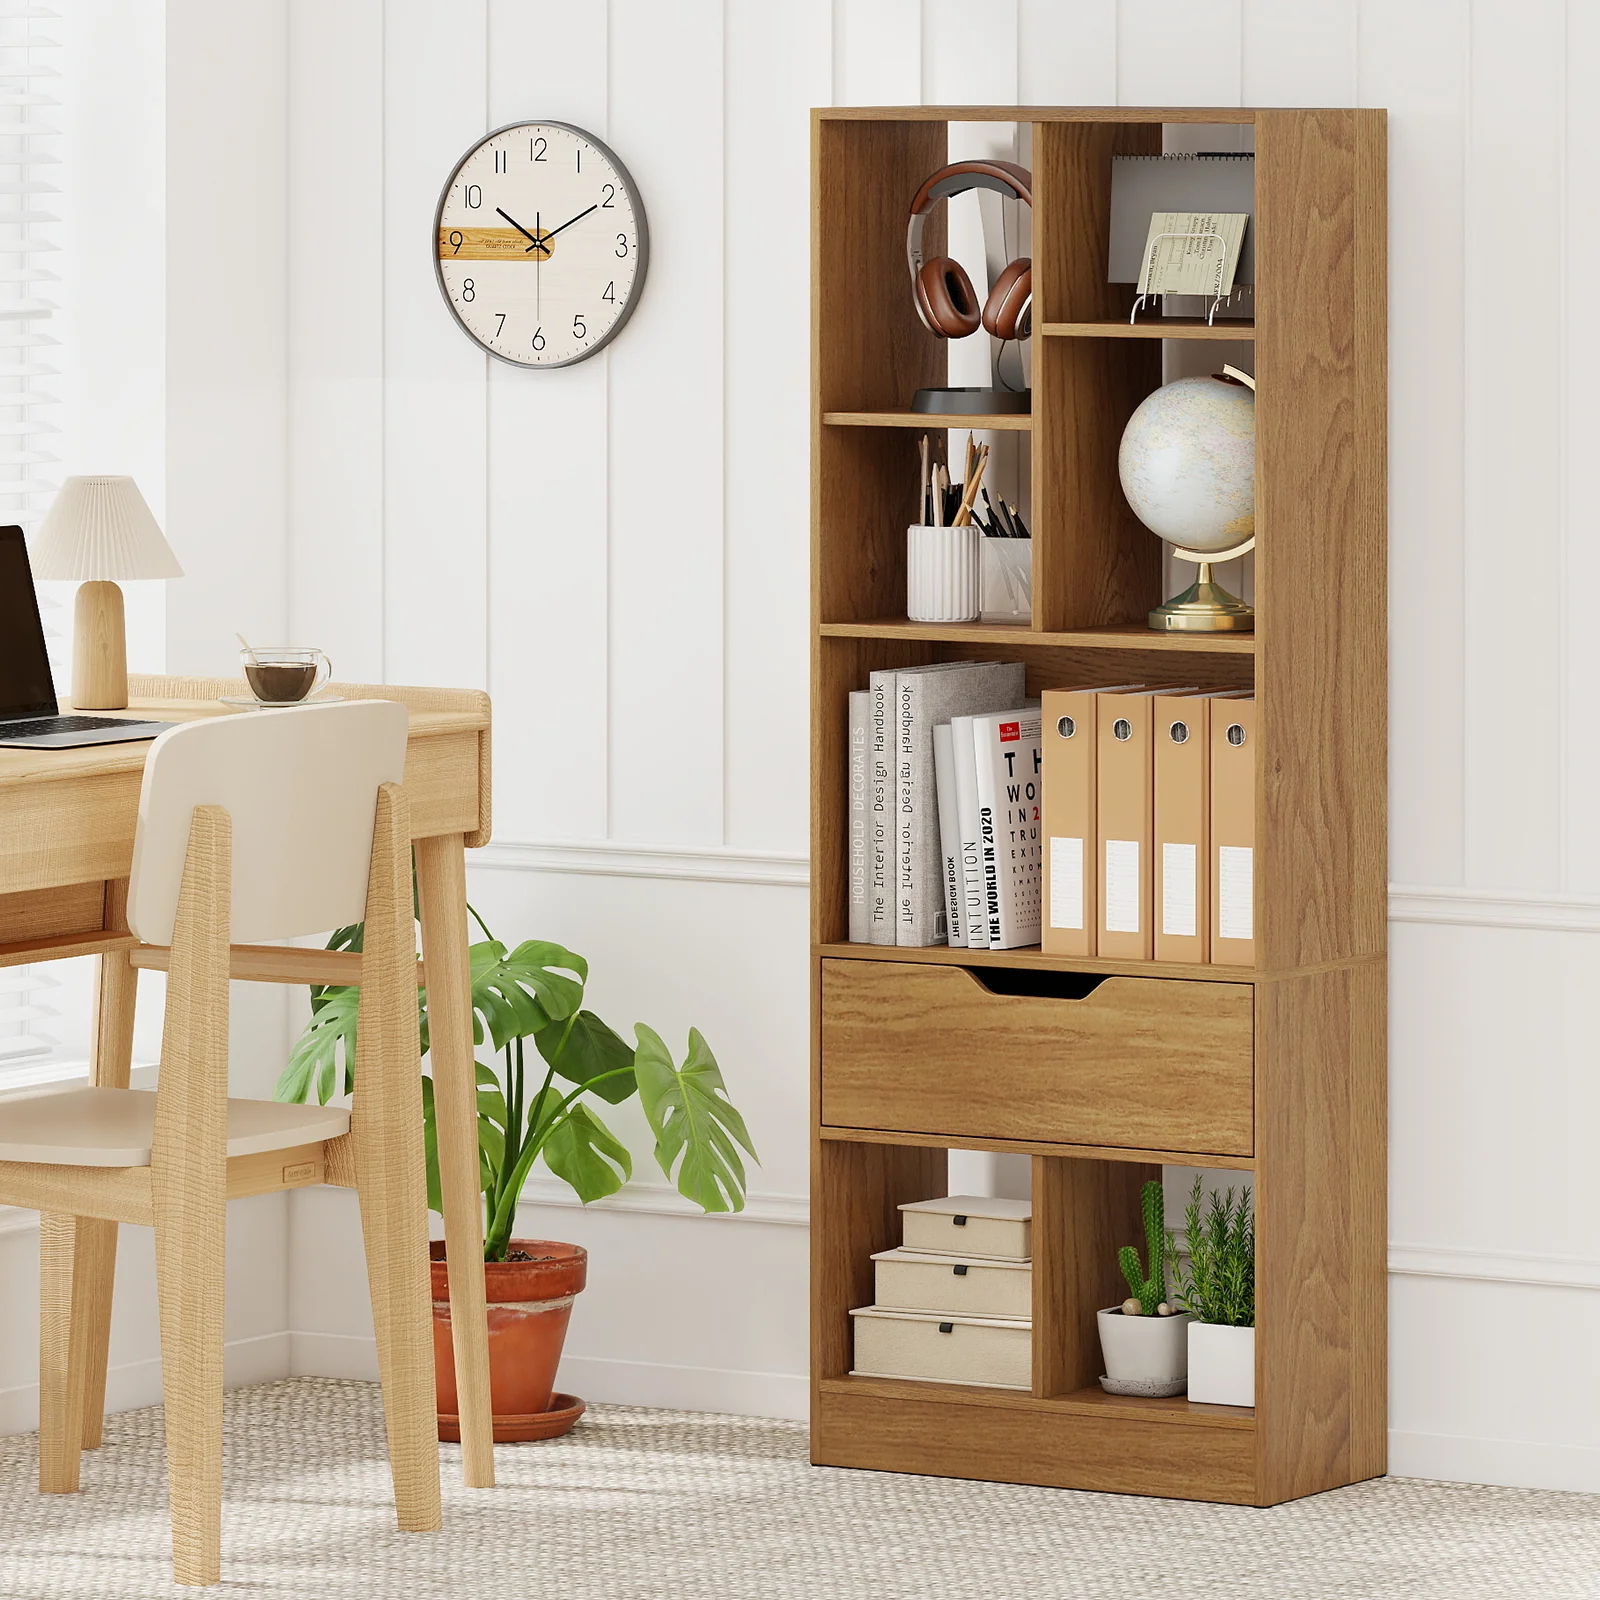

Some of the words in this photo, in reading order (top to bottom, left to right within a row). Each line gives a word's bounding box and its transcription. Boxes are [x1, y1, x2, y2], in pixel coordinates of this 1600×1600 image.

[495, 150, 507, 174] 11
[530, 137, 548, 162] 12
[464, 184, 482, 209] 10
[601, 183, 615, 208] 2
[449, 230, 464, 255] 9
[615, 234, 628, 258] 3
[462, 278, 476, 303] 8
[601, 280, 616, 304] 4
[495, 314, 507, 338] 7
[572, 314, 587, 339] 5
[531, 327, 546, 351] 6
[874, 684, 884, 752] Handbook
[852, 726, 865, 811] DECORATES
[874, 760, 888, 812] Design
[980, 806, 994, 844] 2020
[1008, 808, 1027, 824] IN
[1010, 828, 1037, 842] TRU
[852, 819, 865, 904] HOUSEHOLD
[874, 822, 884, 888] Interior
[984, 848, 996, 862] IN
[963, 841, 984, 942] INTUITION
[985, 865, 998, 914] WORLD
[1013, 876, 1042, 886] IMAT
[874, 898, 884, 922] The
[988, 917, 1002, 944] THE
